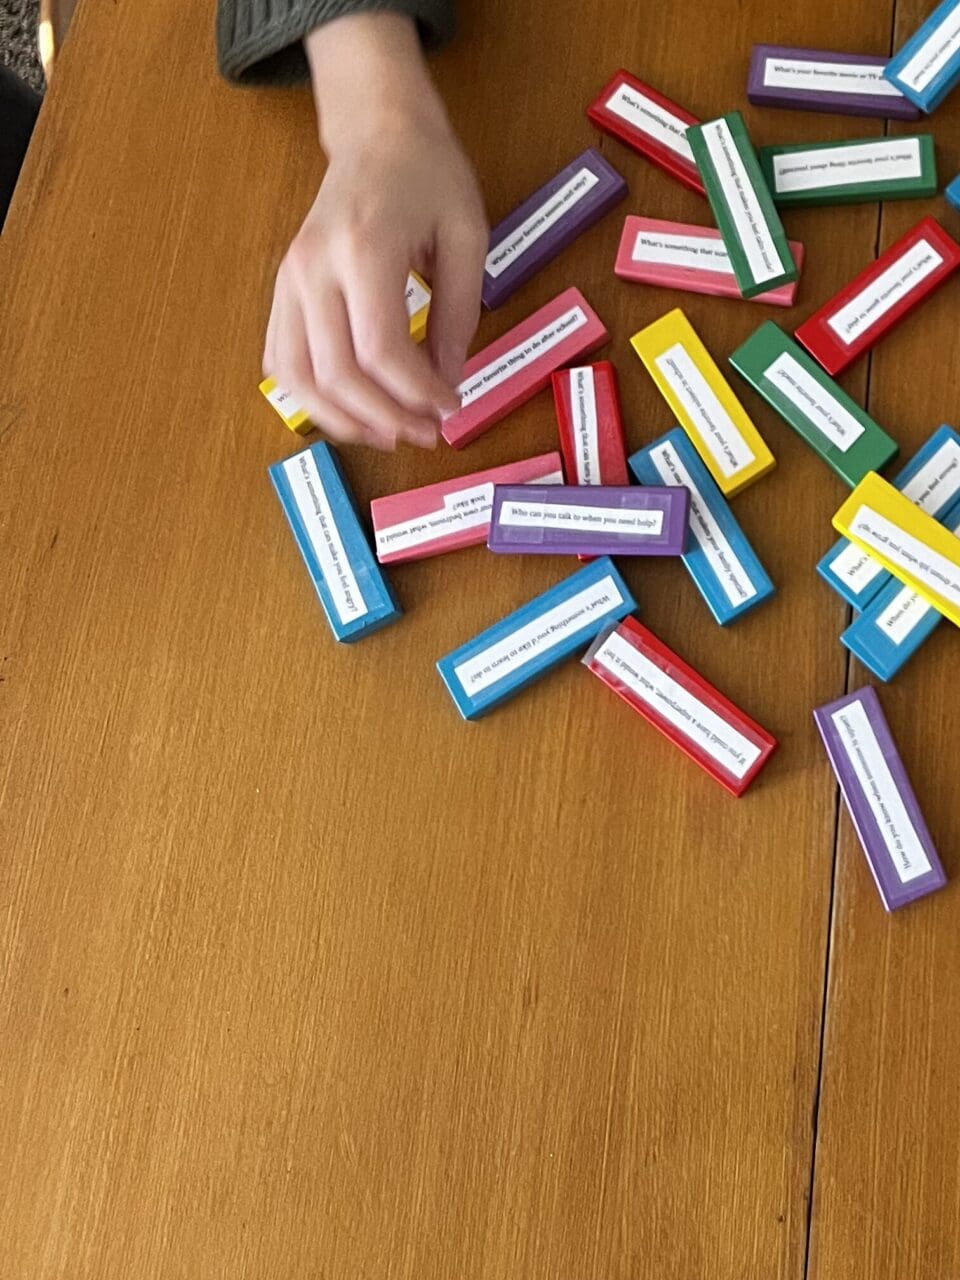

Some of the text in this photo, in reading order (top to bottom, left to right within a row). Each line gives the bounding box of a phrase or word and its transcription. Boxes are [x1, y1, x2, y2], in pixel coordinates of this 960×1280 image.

[773, 65, 797, 74] What's
[812, 69, 838, 77] favorite
[621, 93, 681, 135] What's something that
[490, 247, 513, 266] What's
[510, 235, 525, 251] your
[522, 216, 546, 238] favorite
[562, 189, 575, 203] and
[572, 176, 587, 192] why?
[640, 238, 714, 256] What's something that
[468, 380, 483, 395] your
[482, 363, 508, 383] favorite
[506, 352, 526, 366] thing
[540, 330, 555, 344] after
[555, 313, 579, 334] school?
[452, 494, 486, 511] look like?
[385, 508, 479, 543] own bedroom, what would
[511, 507, 529, 517] Who
[542, 512, 557, 520] you
[557, 512, 572, 520] talk
[581, 514, 603, 523] when
[602, 517, 617, 525] you
[617, 518, 636, 526] need
[636, 518, 657, 529] help?
[298, 455, 359, 612] What's something that can make you feel angry?
[585, 594, 611, 611] What's
[549, 608, 586, 633] something
[530, 628, 551, 647] you'd
[517, 641, 532, 653] like
[603, 648, 616, 661] be?
[490, 654, 511, 669] learn
[619, 661, 640, 679] would
[470, 670, 483, 684] do?
[638, 676, 655, 692] what
[655, 687, 692, 721] superpower,
[695, 722, 712, 739] have
[709, 733, 729, 750] could
[727, 747, 743, 760] you
